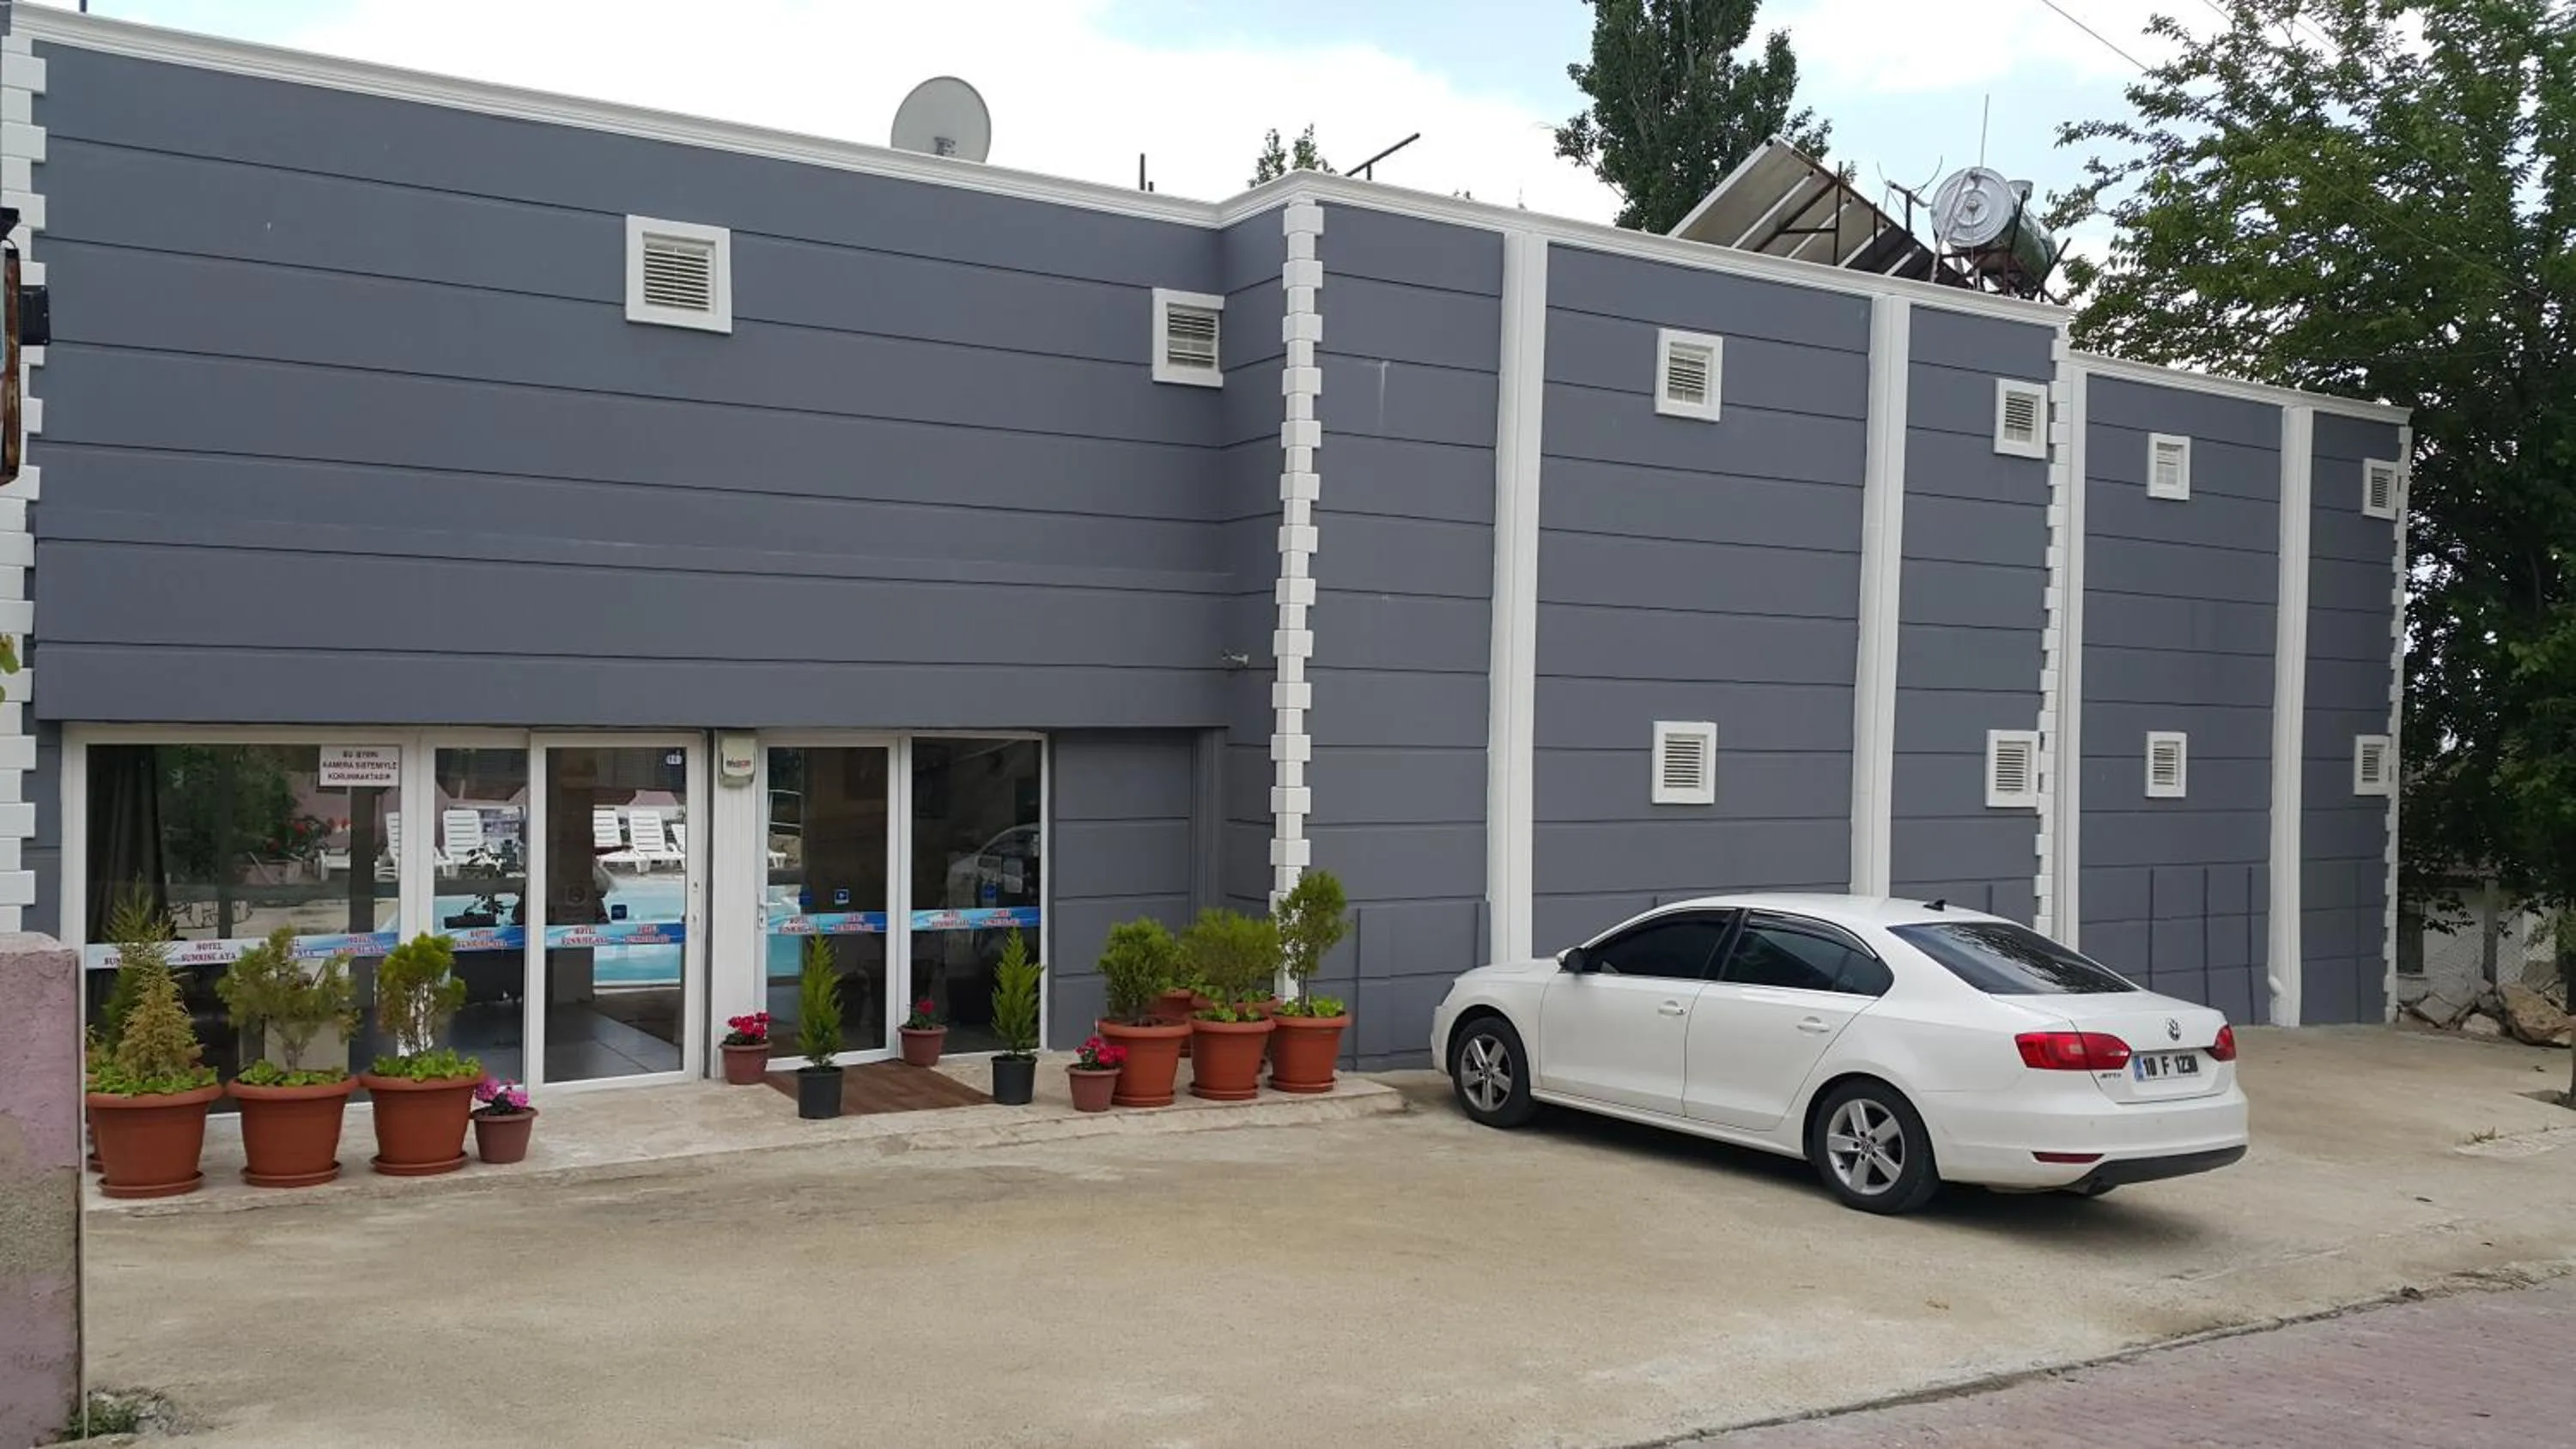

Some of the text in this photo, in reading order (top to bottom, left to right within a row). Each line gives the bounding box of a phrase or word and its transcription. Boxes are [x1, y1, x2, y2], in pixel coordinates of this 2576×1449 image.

[196, 942, 222, 950] HOTEL
[2143, 1057, 2157, 1076] 10
[2160, 1055, 2171, 1076] F
